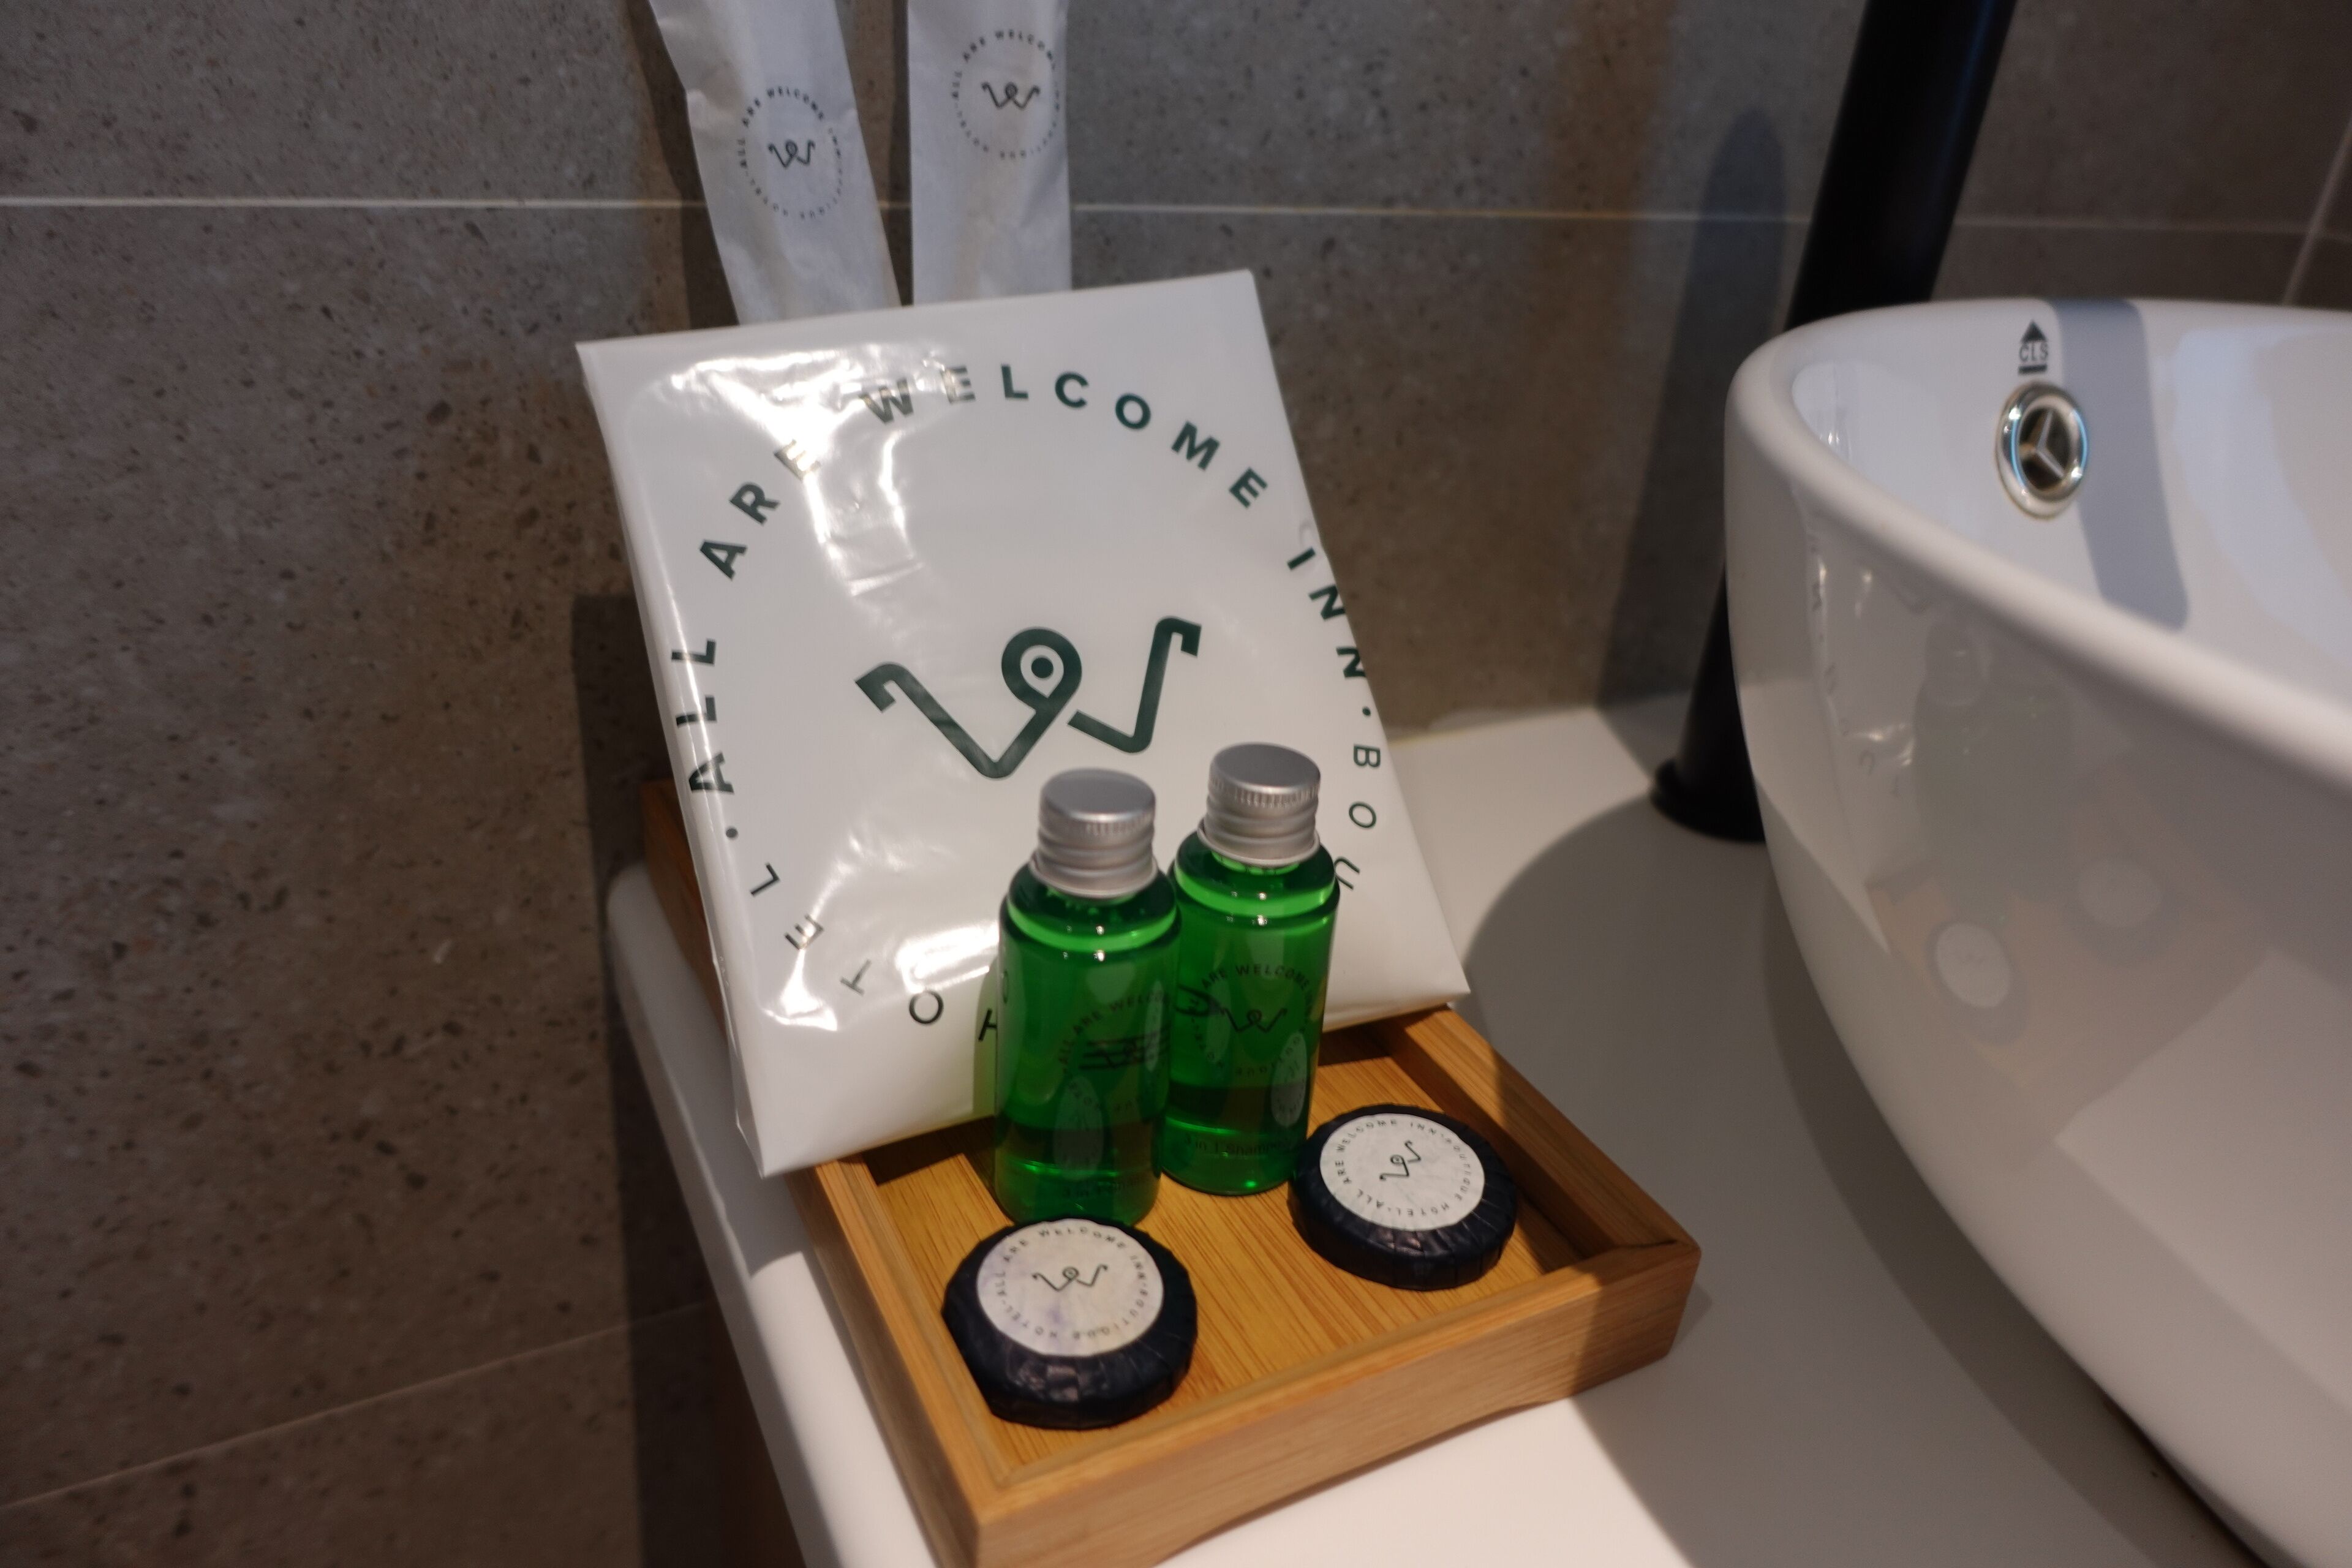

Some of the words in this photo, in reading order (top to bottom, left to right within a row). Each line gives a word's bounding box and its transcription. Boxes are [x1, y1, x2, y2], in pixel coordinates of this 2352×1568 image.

[2019, 339, 2049, 362] CLS
[859, 364, 1268, 509] WELCOME
[699, 439, 821, 581] ARE
[1287, 547, 1366, 680] INN
[671, 639, 734, 794] ALL
[1334, 1159, 1352, 1185] ARE
[1335, 1118, 1398, 1154] WELCOME
[1037, 1226, 1128, 1250] WELCOME
